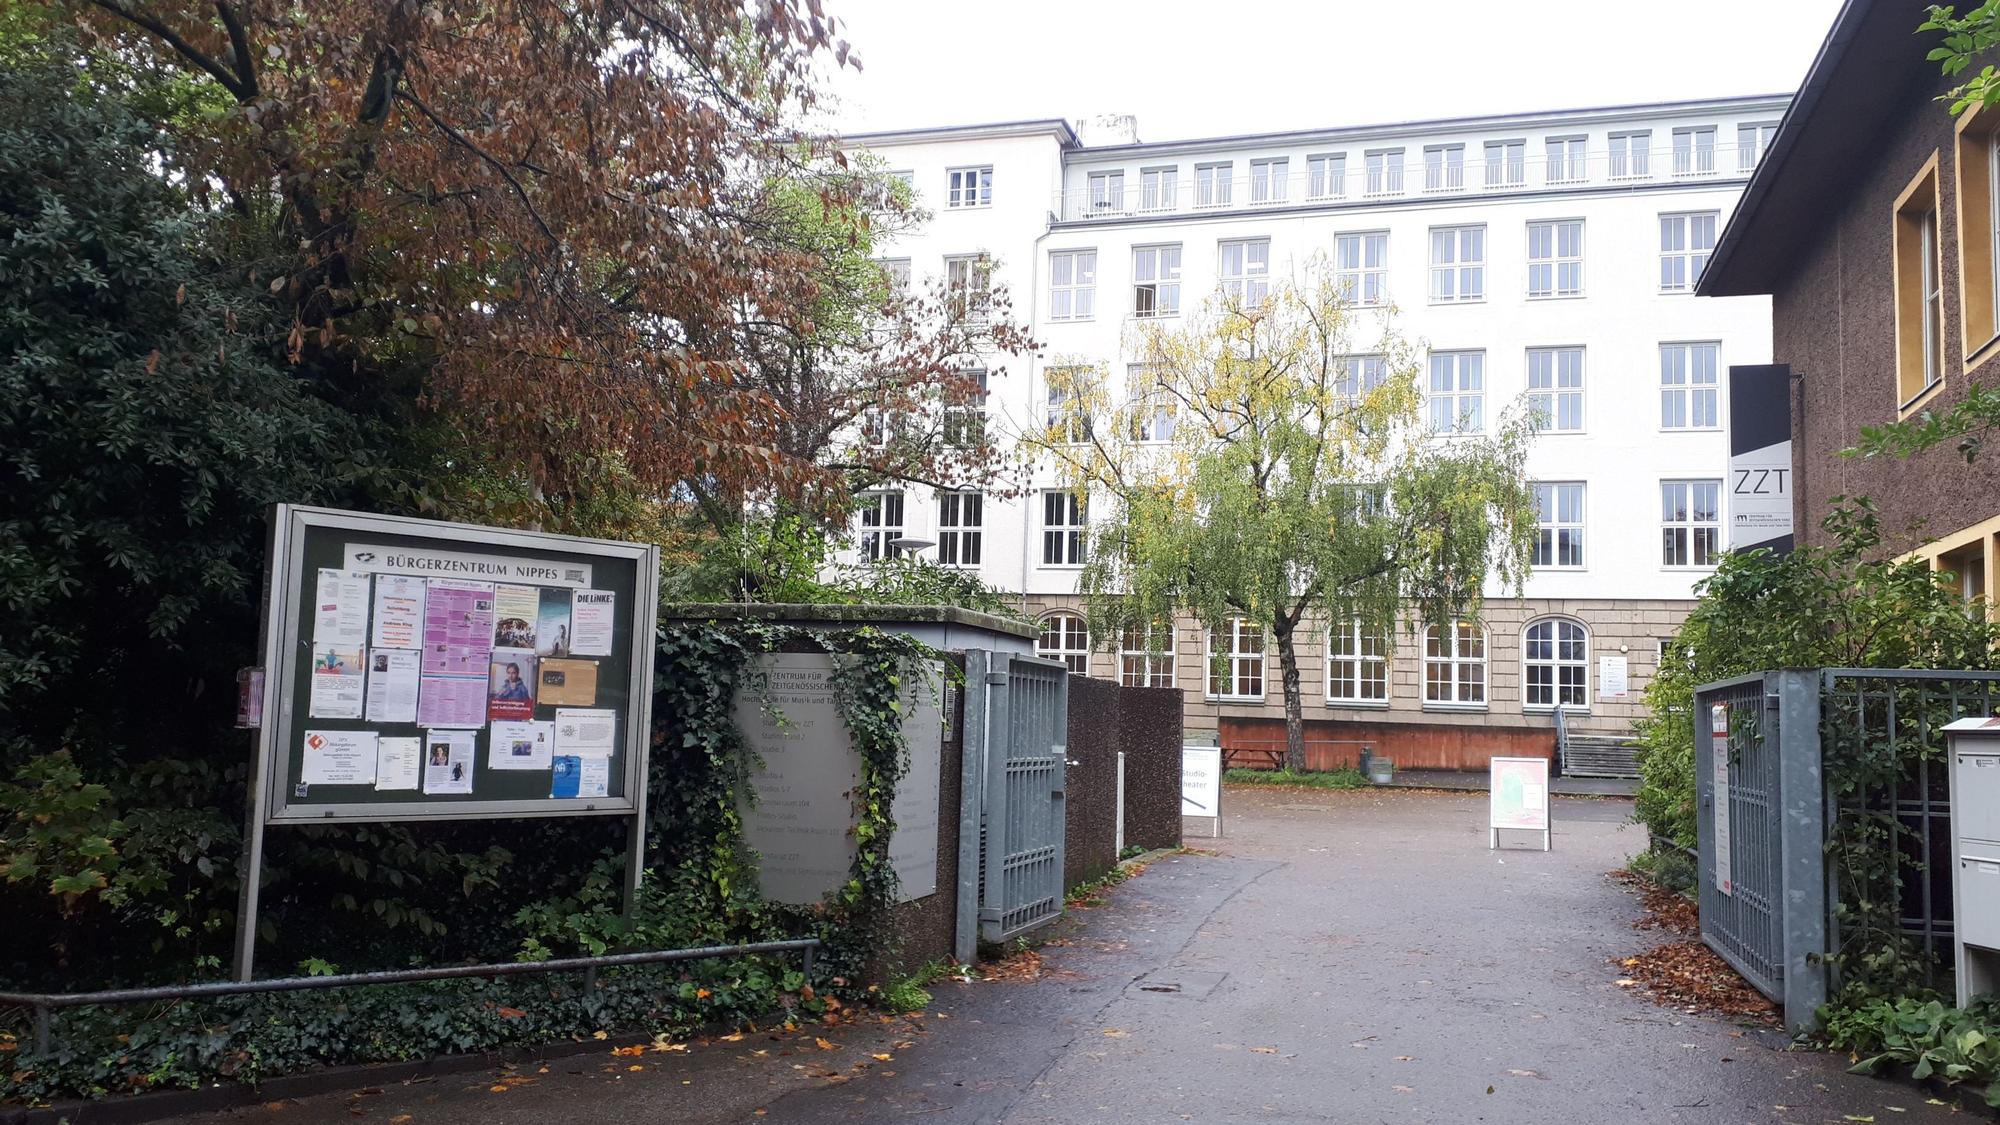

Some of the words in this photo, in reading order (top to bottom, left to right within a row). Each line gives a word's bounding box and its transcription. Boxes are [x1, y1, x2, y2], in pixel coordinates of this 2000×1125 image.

[1735, 470, 1789, 493] ZZT
[386, 554, 508, 576] BÜRGERZENTRUM
[516, 566, 558, 580] NIPPES
[577, 594, 589, 603] DIE
[772, 672, 806, 680] ZENTRUM
[807, 671, 822, 680] FÜR
[779, 695, 789, 703] für
[791, 696, 810, 704] Musik
[811, 696, 825, 704] und
